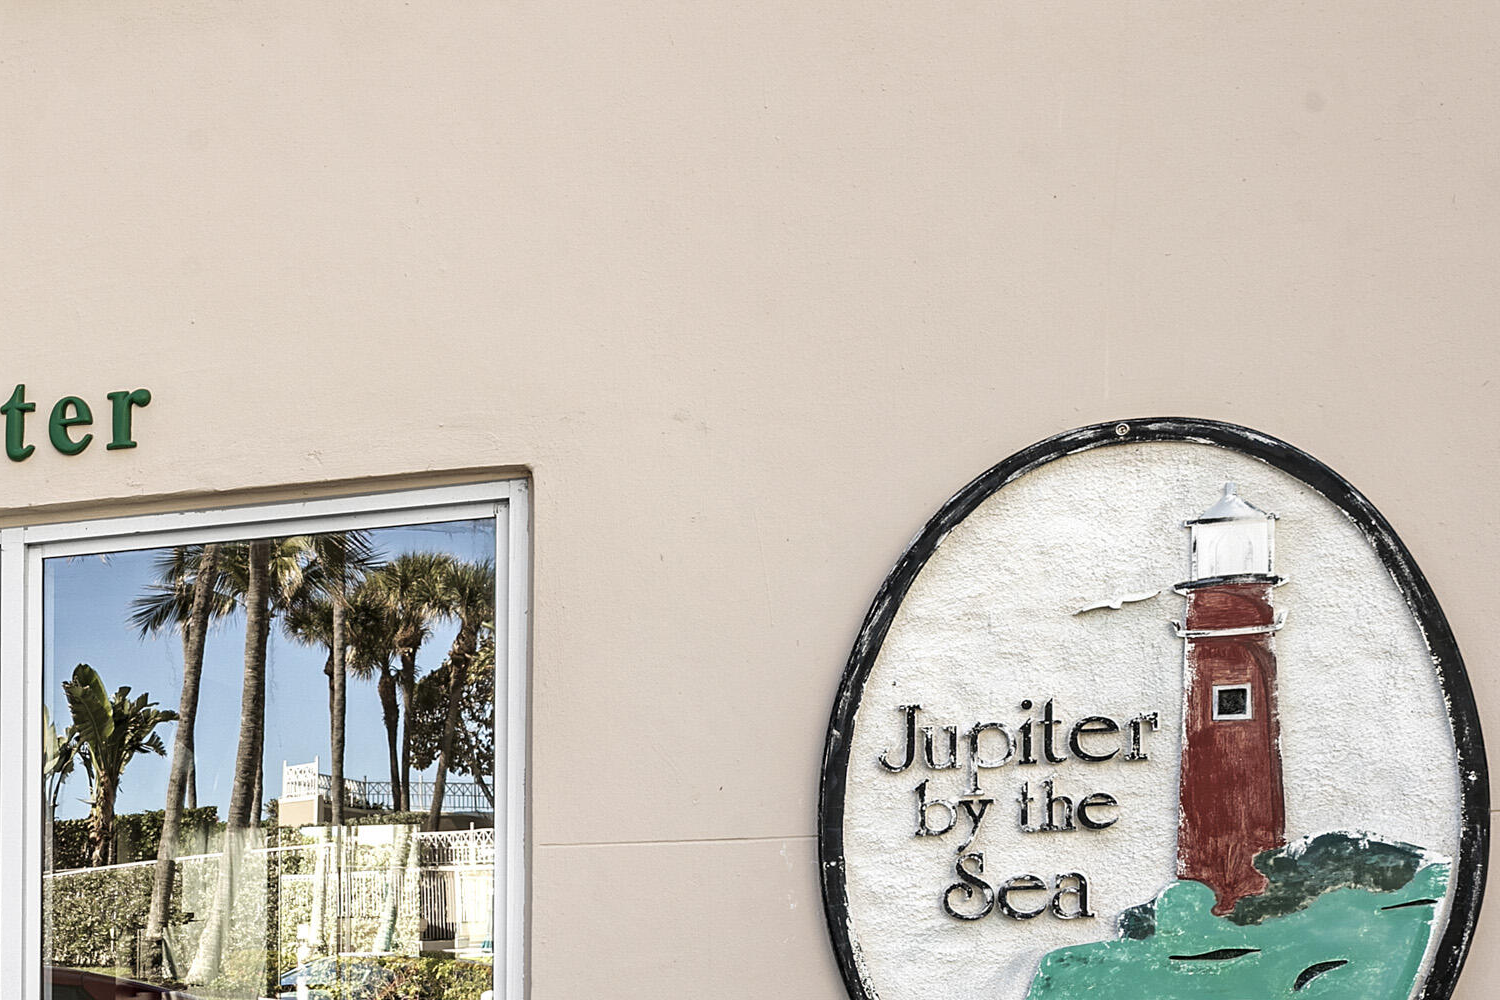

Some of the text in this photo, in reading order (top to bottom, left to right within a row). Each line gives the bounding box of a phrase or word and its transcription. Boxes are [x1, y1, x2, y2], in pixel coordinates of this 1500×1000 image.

[878, 698, 1159, 796] Jupiter
[914, 774, 1119, 853] by the
[943, 852, 1095, 921] Sea
